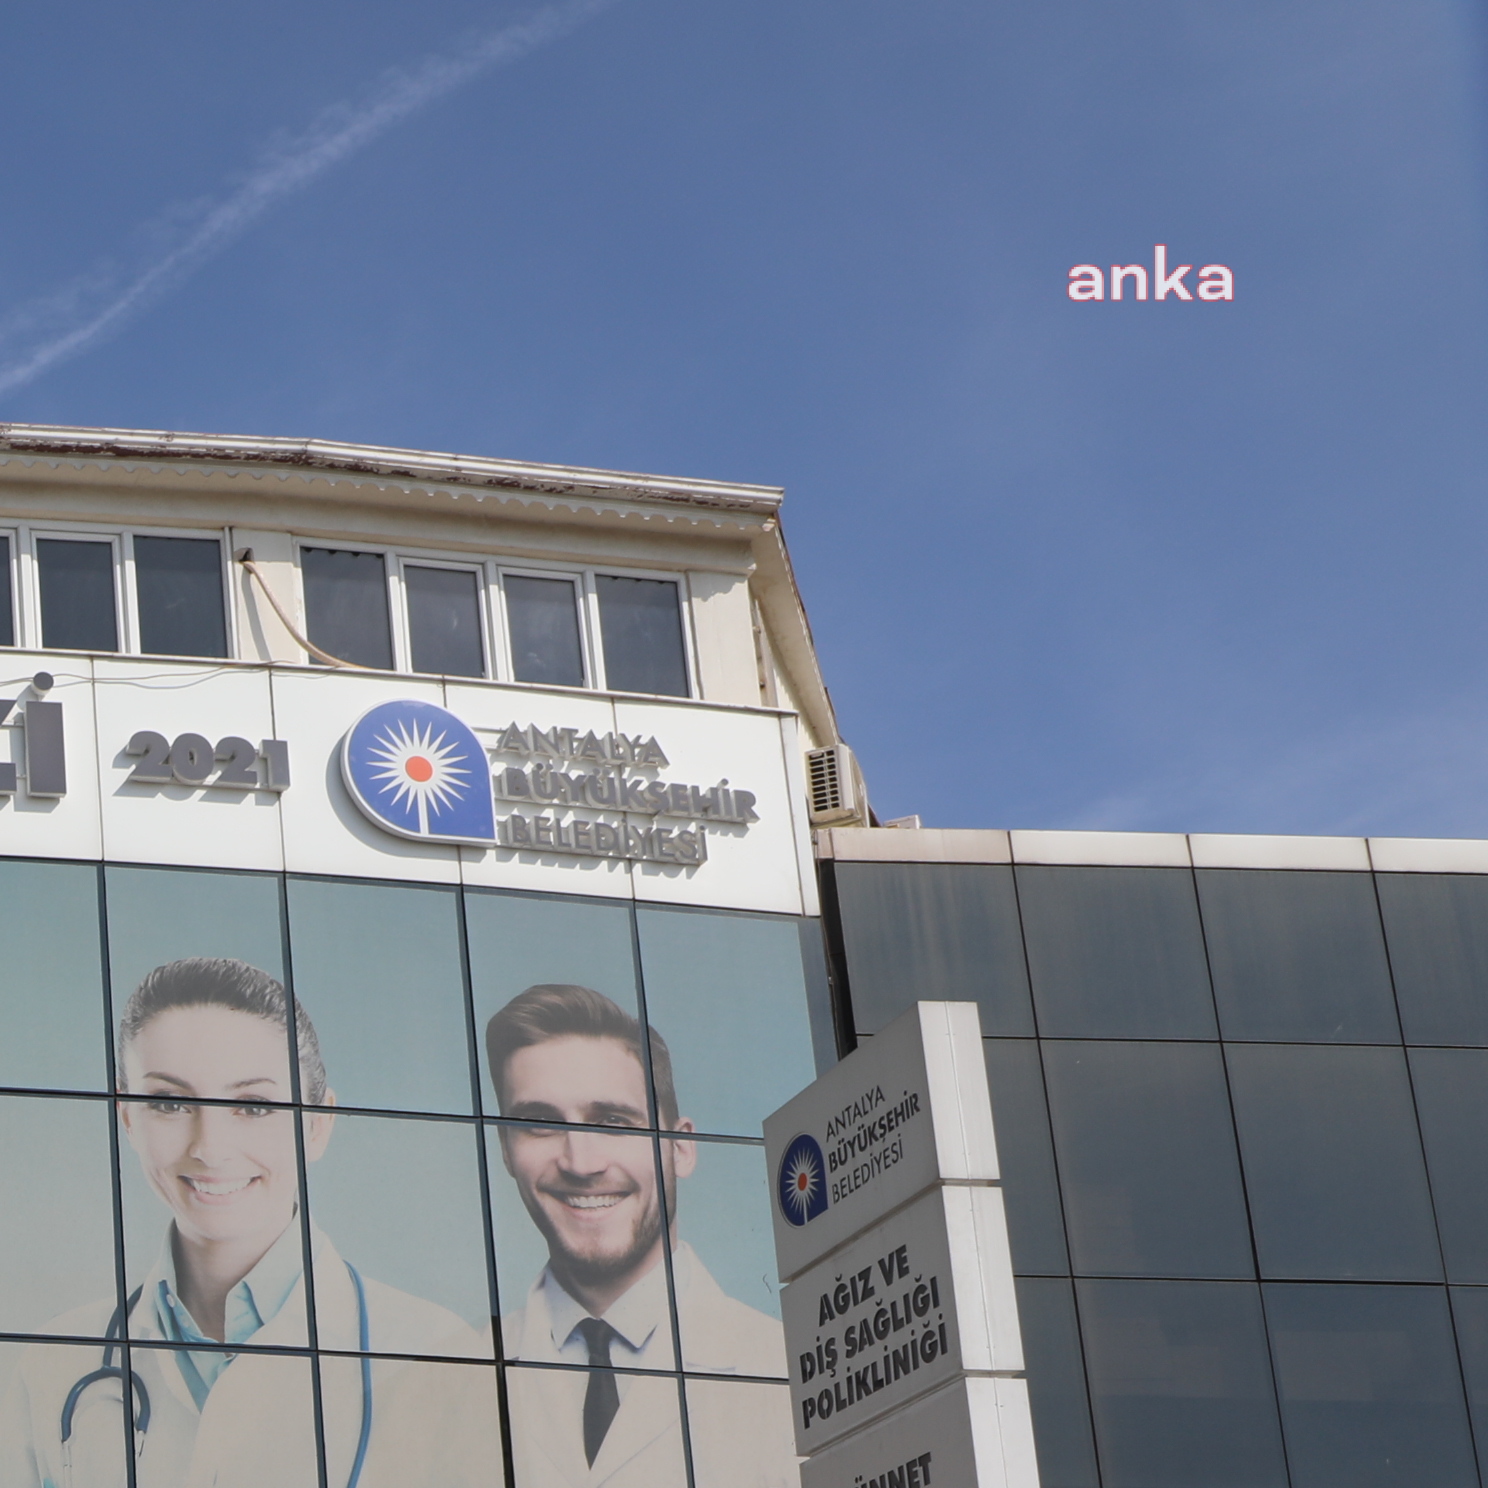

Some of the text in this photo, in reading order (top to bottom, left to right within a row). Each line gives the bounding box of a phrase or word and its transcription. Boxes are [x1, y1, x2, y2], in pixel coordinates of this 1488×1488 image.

[126, 729, 292, 794] 2021
[499, 720, 671, 769] ANTALYA
[505, 761, 761, 824] BÜYÜKŞEHİR
[506, 813, 708, 866] BELEDİYESİ
[824, 1084, 887, 1143] ANTALYA
[827, 1090, 922, 1175] BÜYÜKŞEHİR
[831, 1133, 905, 1205] BELEDİYESİ
[818, 1244, 911, 1328] AĞIZ VE
[799, 1274, 941, 1385] DİŞ SAĞLIĞI
[801, 1313, 949, 1430] POLİKLİNİĞİ
